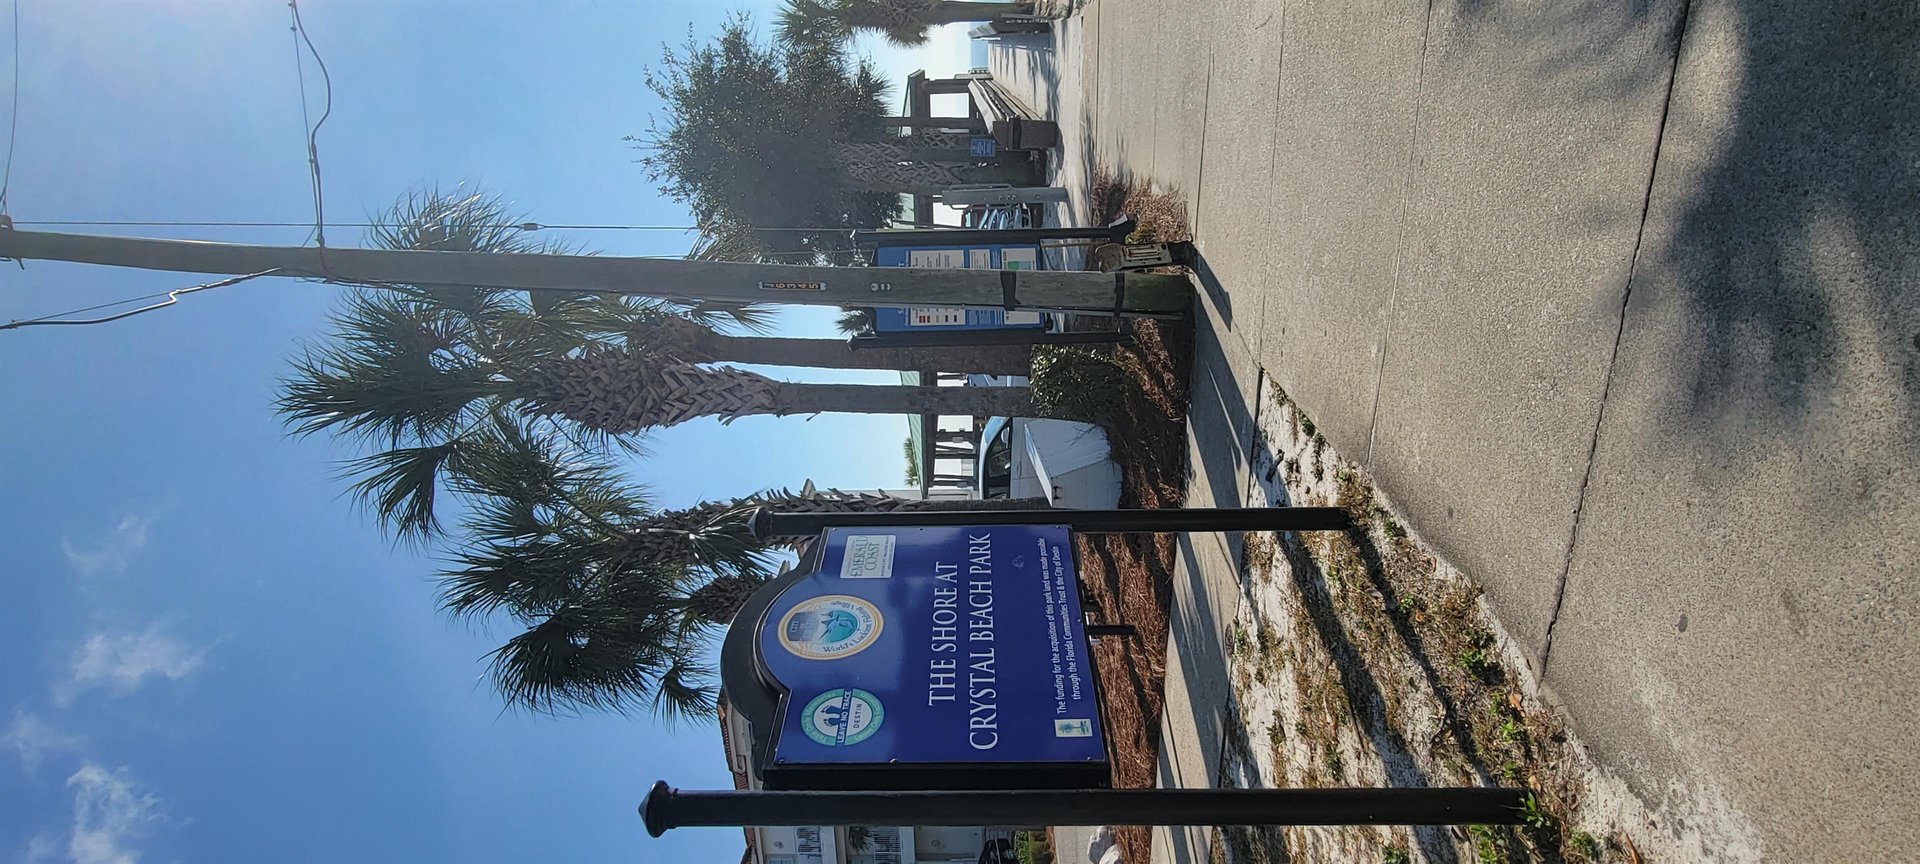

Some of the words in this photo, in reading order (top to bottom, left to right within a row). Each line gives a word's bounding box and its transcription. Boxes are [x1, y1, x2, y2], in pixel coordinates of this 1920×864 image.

[850, 536, 869, 577] EMERALD
[864, 543, 880, 570] COAST
[969, 533, 992, 574] PARK
[1037, 538, 1049, 556] possible
[1051, 546, 1060, 560] Destin
[935, 562, 958, 584] AT
[1040, 557, 1048, 570] made
[1054, 567, 1064, 576] City
[1042, 580, 1051, 591] land
[1055, 576, 1064, 585] the
[1043, 592, 1055, 604] park
[1058, 590, 1067, 603] Trust
[969, 580, 994, 642] BEACH
[1045, 604, 1054, 614] this
[931, 587, 958, 652] SHORE
[1060, 604, 1072, 640] Communities
[1048, 622, 1060, 652] acquisition
[1051, 653, 1060, 663] the
[1065, 641, 1076, 661] Florida
[1052, 664, 1062, 674] for
[1067, 662, 1077, 672] the
[928, 659, 956, 706] THE
[1054, 674, 1065, 700] funding
[1068, 673, 1081, 700] through
[842, 690, 852, 710] TRACE
[969, 647, 998, 750] CRYSTAL
[1056, 701, 1067, 714] The
[840, 712, 848, 721] NO
[853, 704, 862, 728] DESTIN
[837, 722, 847, 743] LEAVE
